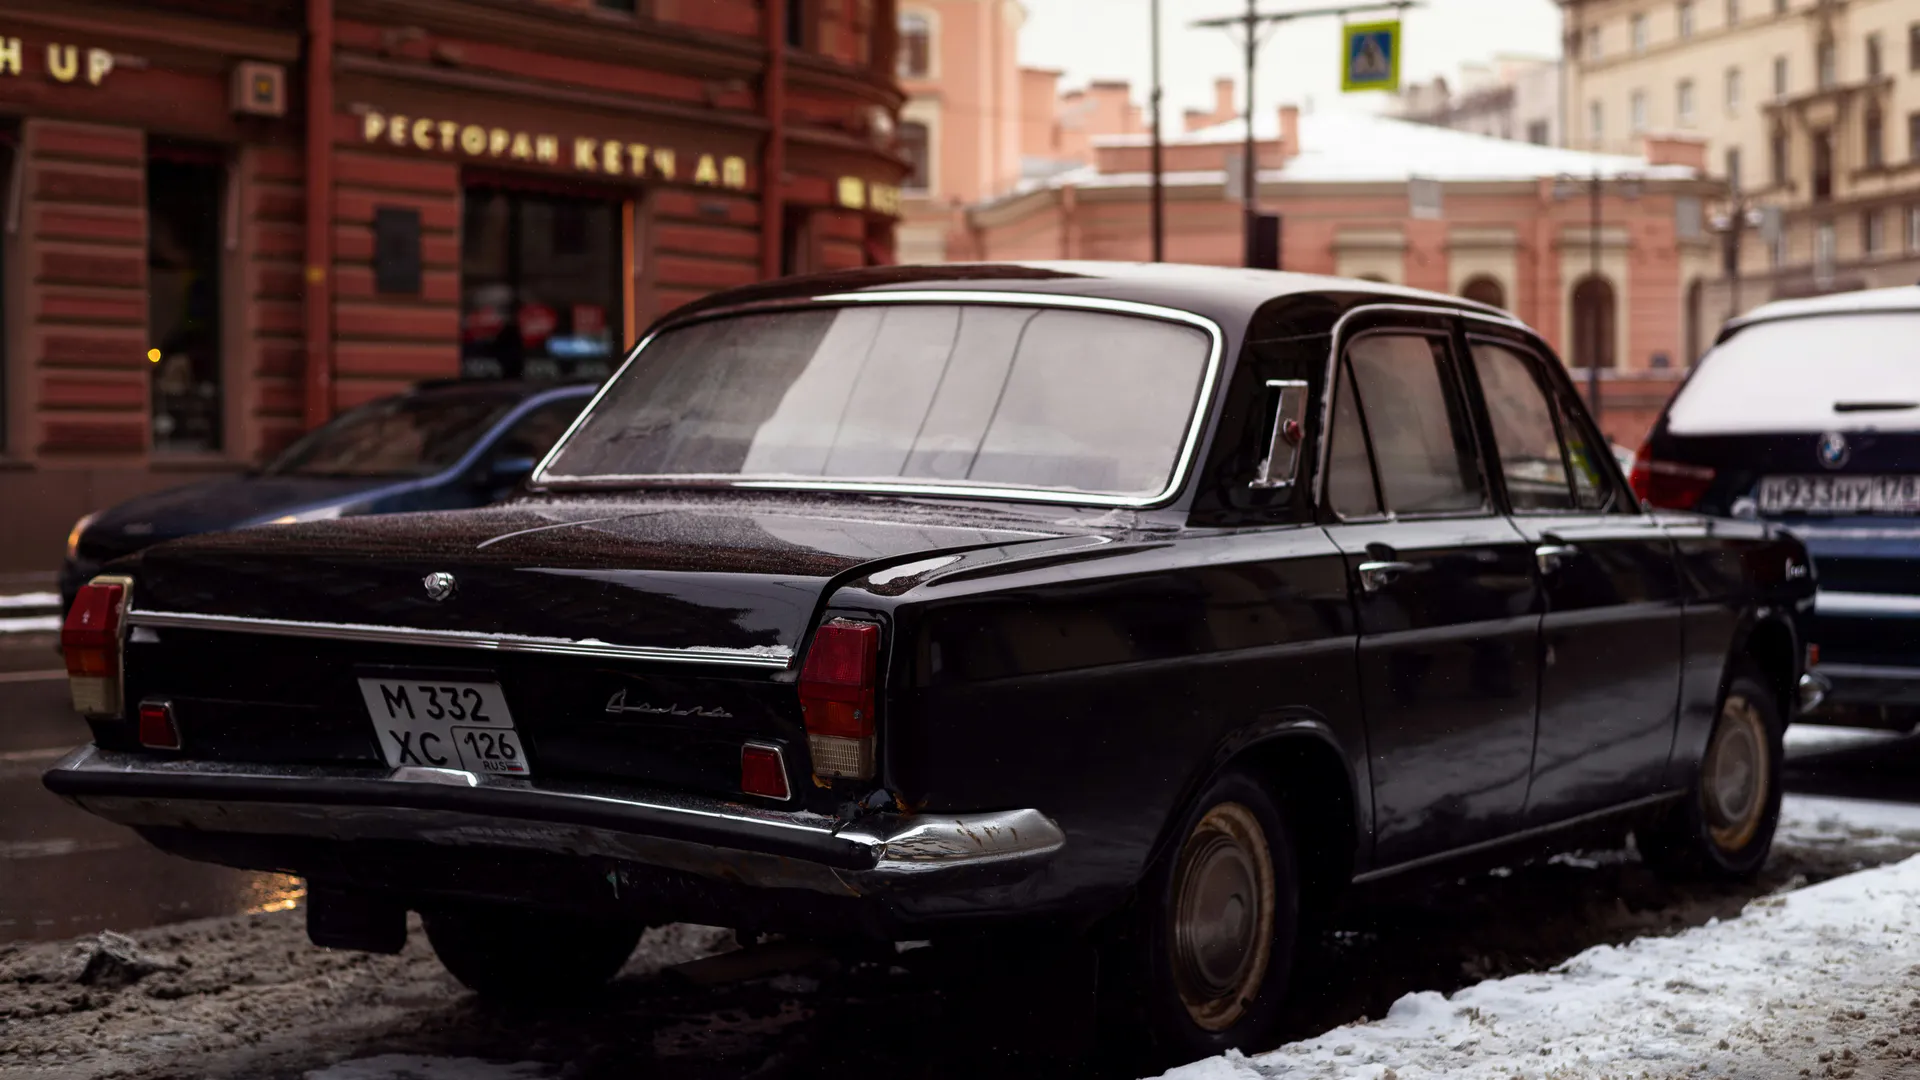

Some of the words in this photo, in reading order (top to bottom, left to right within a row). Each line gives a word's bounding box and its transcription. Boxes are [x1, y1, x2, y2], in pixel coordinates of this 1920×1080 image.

[47, 43, 114, 86] UP
[365, 112, 559, 164] РЕСТОРАН
[574, 137, 676, 181] КЕТЧ
[695, 153, 746, 190] АП
[418, 686, 490, 722] 332
[389, 730, 448, 766] ХС
[464, 732, 516, 760] 126
[484, 760, 507, 772] RUS
